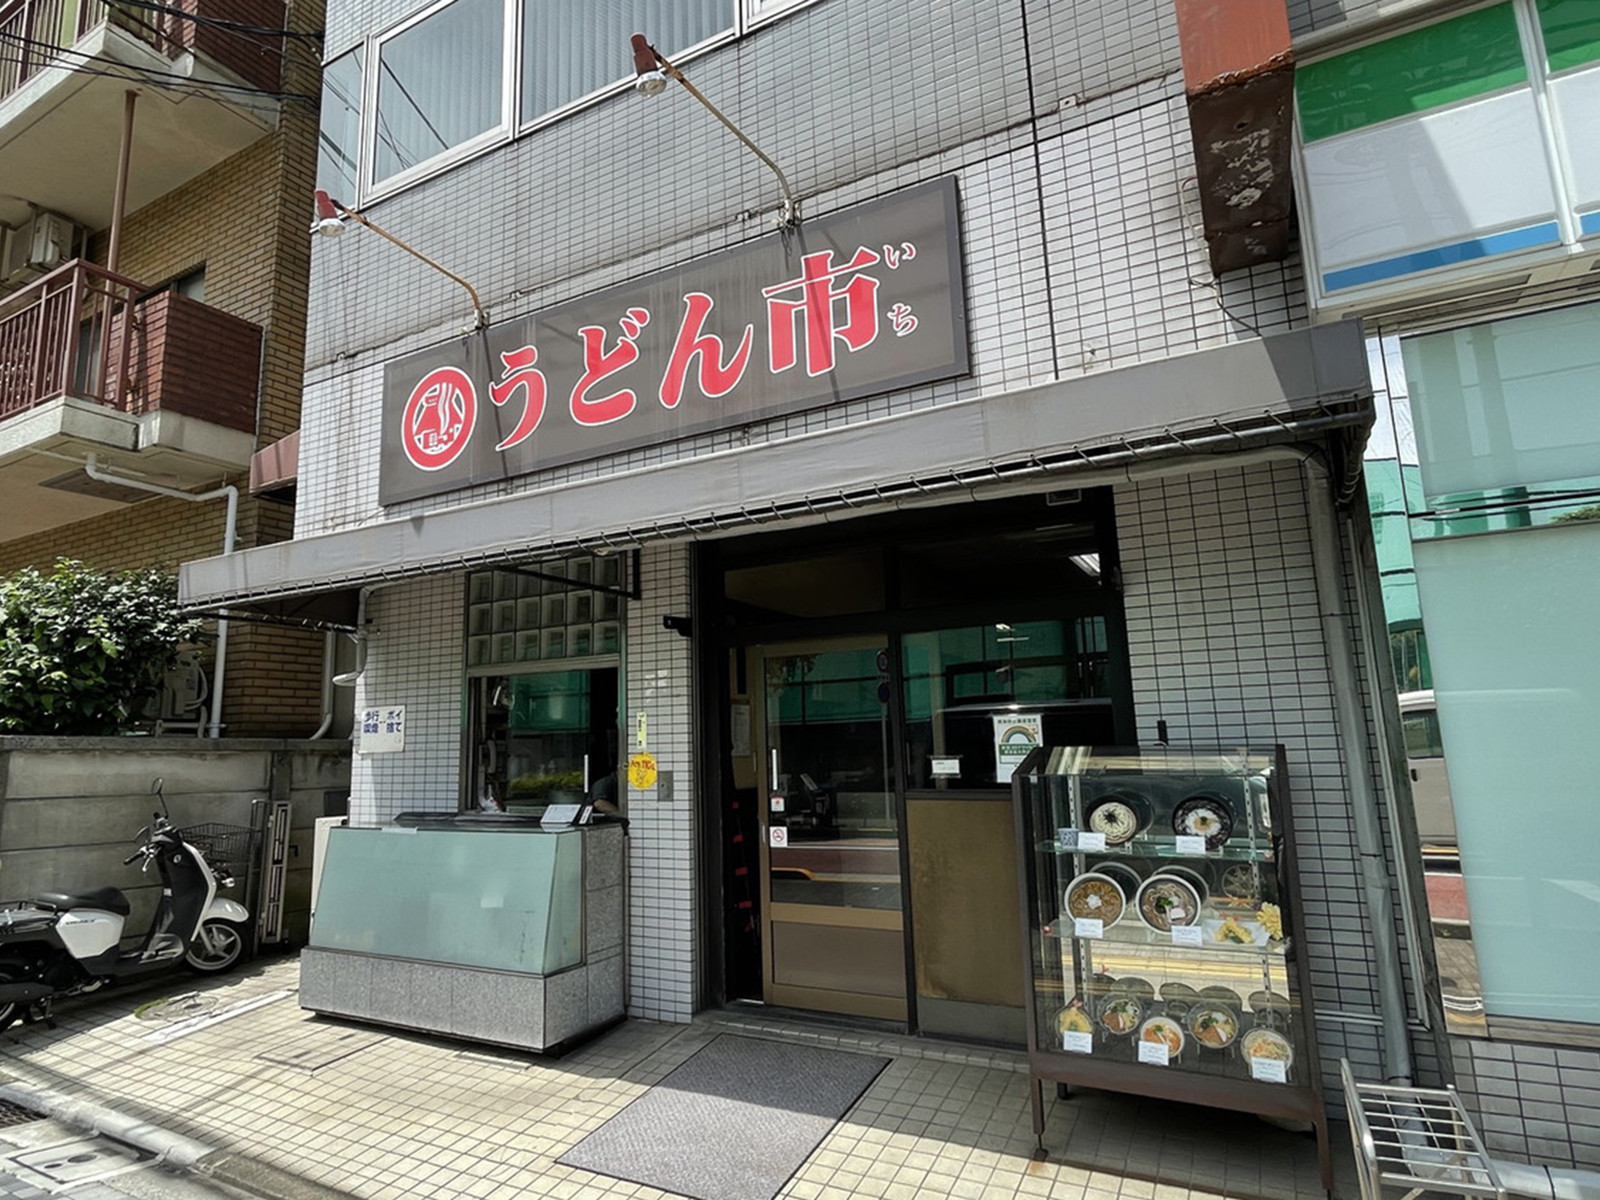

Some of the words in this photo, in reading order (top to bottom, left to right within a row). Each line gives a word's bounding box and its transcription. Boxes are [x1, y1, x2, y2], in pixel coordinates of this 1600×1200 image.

[488, 246, 880, 452] うどん市
[884, 242, 918, 338] いち
